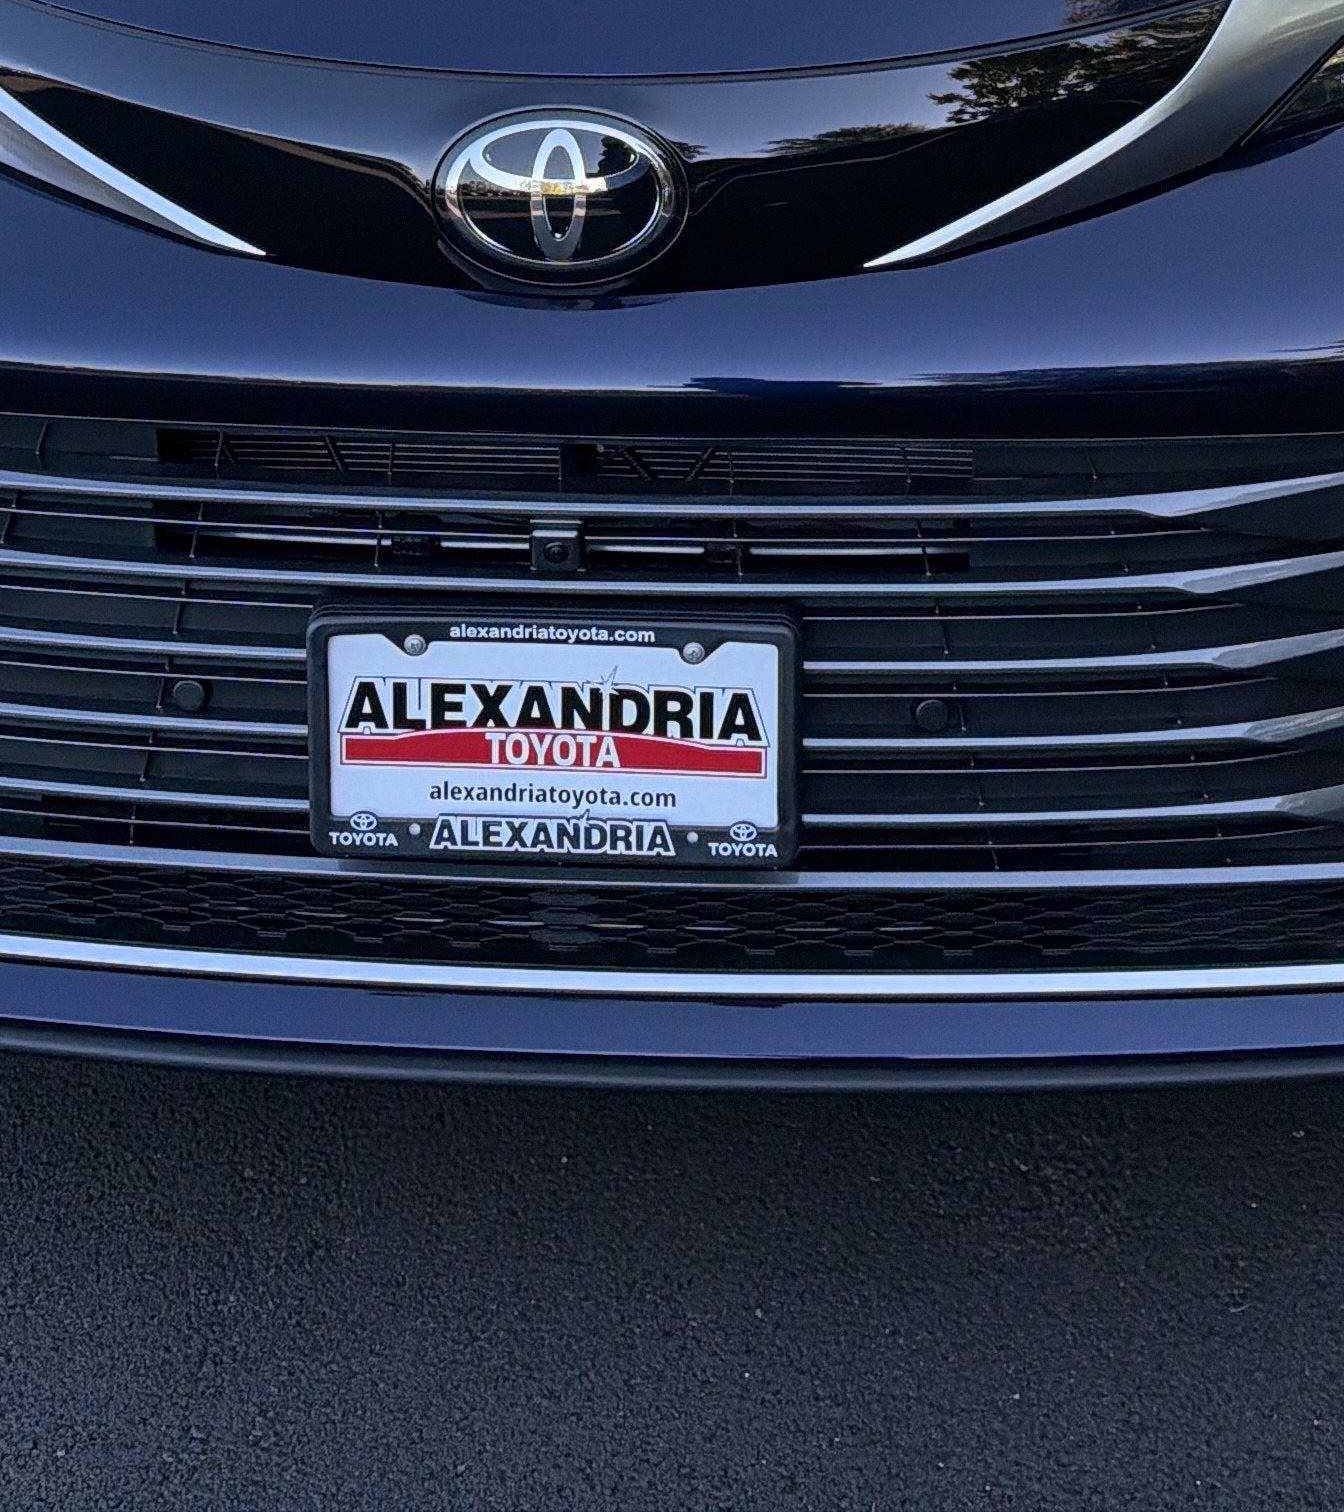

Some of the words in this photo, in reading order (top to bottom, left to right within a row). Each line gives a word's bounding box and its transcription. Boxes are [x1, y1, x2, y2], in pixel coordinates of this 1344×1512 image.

[450, 624, 655, 644] alexandriatoyota.com
[344, 680, 763, 742] ALEXANDRIA
[484, 732, 621, 768] TOYOTA
[429, 780, 677, 810] alexandriatoyota.com
[329, 831, 399, 847] TOYOTA
[430, 816, 675, 856] ALEXANDRIA
[708, 842, 778, 858] TOYOTA
